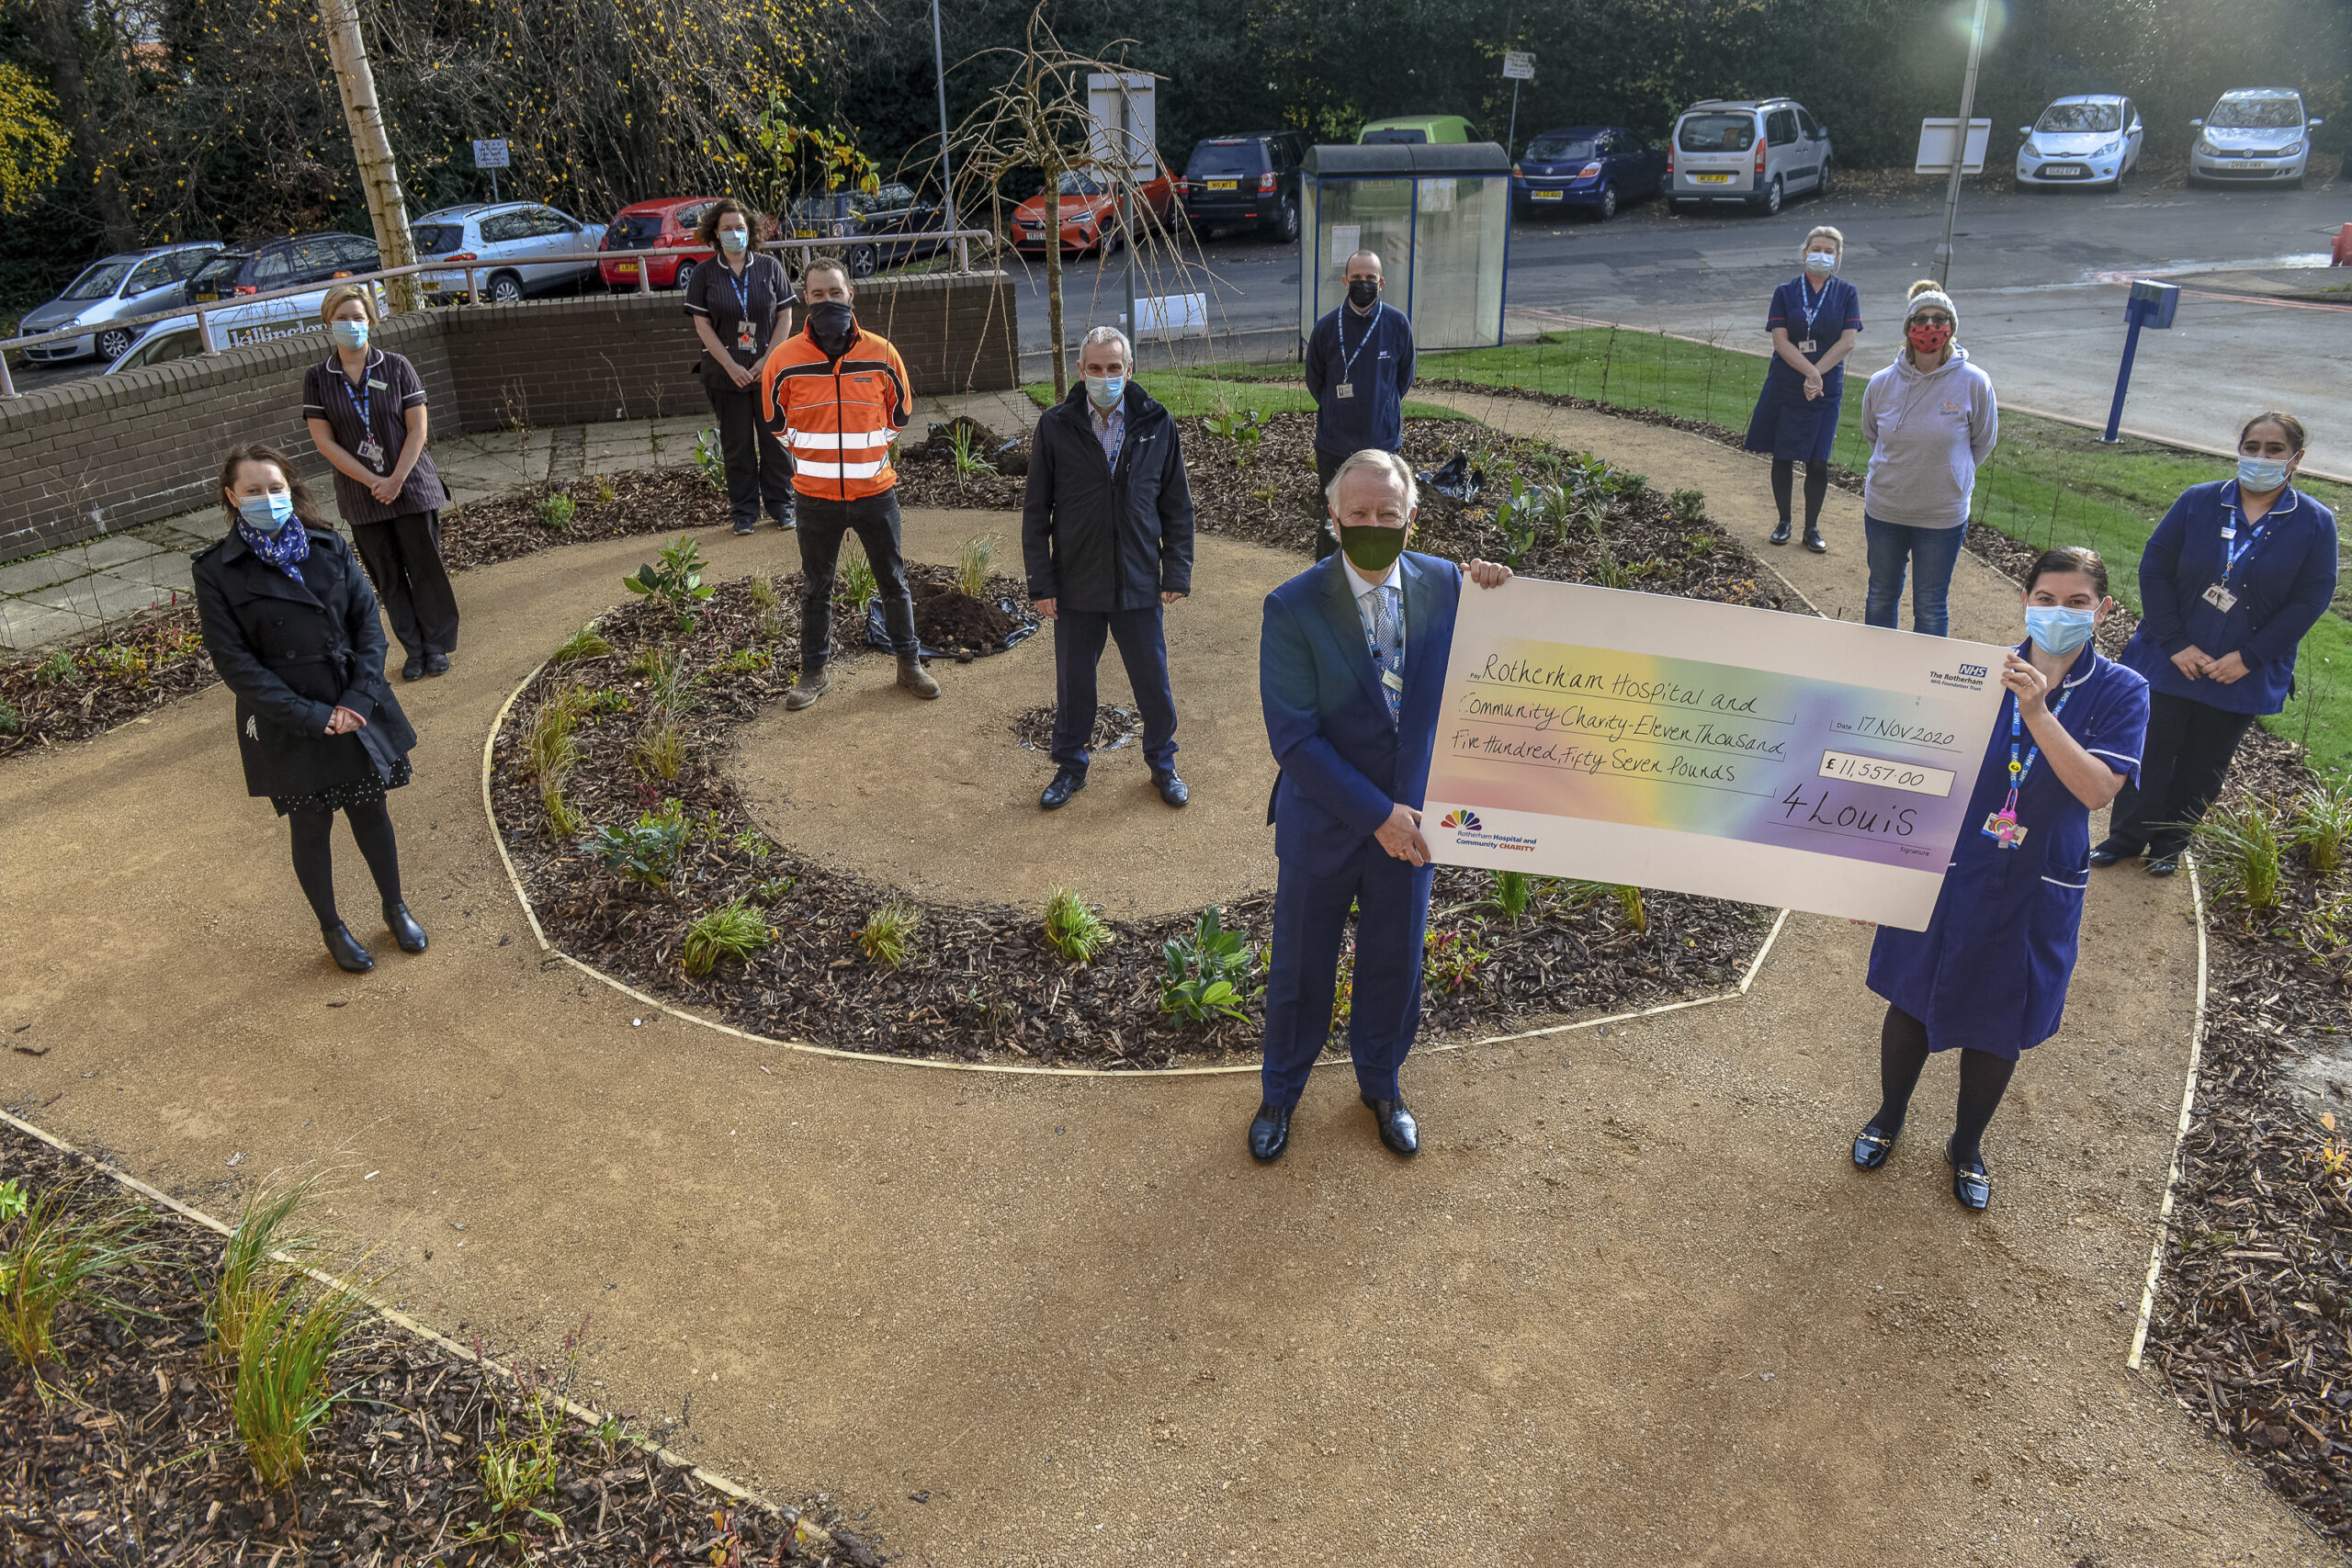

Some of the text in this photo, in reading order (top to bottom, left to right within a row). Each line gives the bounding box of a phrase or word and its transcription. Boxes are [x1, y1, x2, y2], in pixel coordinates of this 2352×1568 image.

[1470, 672, 1482, 682] Pay
[1960, 664, 1986, 678] NHS
[1482, 653, 1758, 714] Rotherham Hospital and
[1930, 671, 1983, 686] The Rotherham
[1941, 681, 1968, 690] Foundation
[1837, 722, 1852, 730] Date
[1857, 716, 1876, 732] 17
[1909, 728, 1954, 745] 2020
[1452, 729, 1479, 750] Five
[1612, 749, 1663, 773] Seven
[1825, 761, 1837, 771] £
[1781, 783, 1808, 818] 4
[1457, 829, 1492, 841] Rotherham
[1493, 834, 1522, 844] Hospital
[1456, 838, 1535, 852] Community CHARITY
[1900, 846, 1930, 857] Signature
